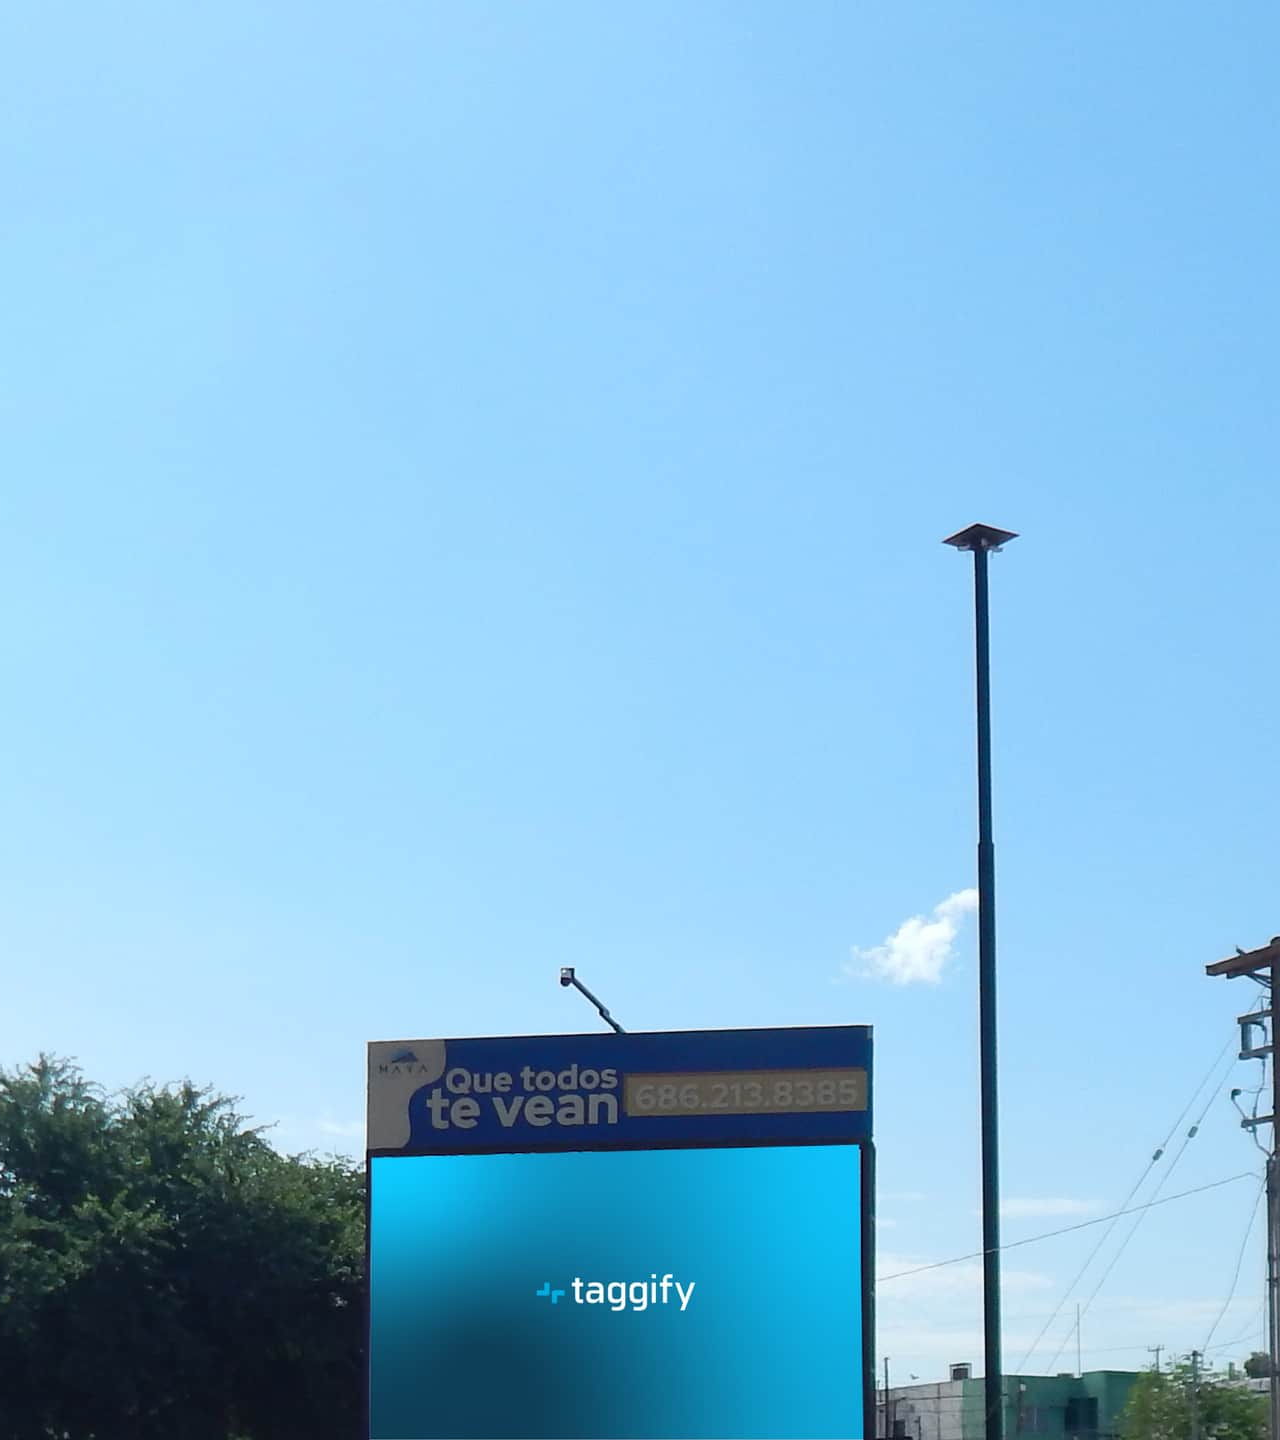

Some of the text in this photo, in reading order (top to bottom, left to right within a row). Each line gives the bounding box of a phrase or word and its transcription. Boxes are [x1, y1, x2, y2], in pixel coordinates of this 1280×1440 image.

[378, 1064, 429, 1075] MAYA
[446, 1063, 618, 1094] Que todos
[426, 1088, 618, 1129] te vean
[634, 1079, 858, 1110] 686.213.8385
[571, 1273, 696, 1311] taggify
